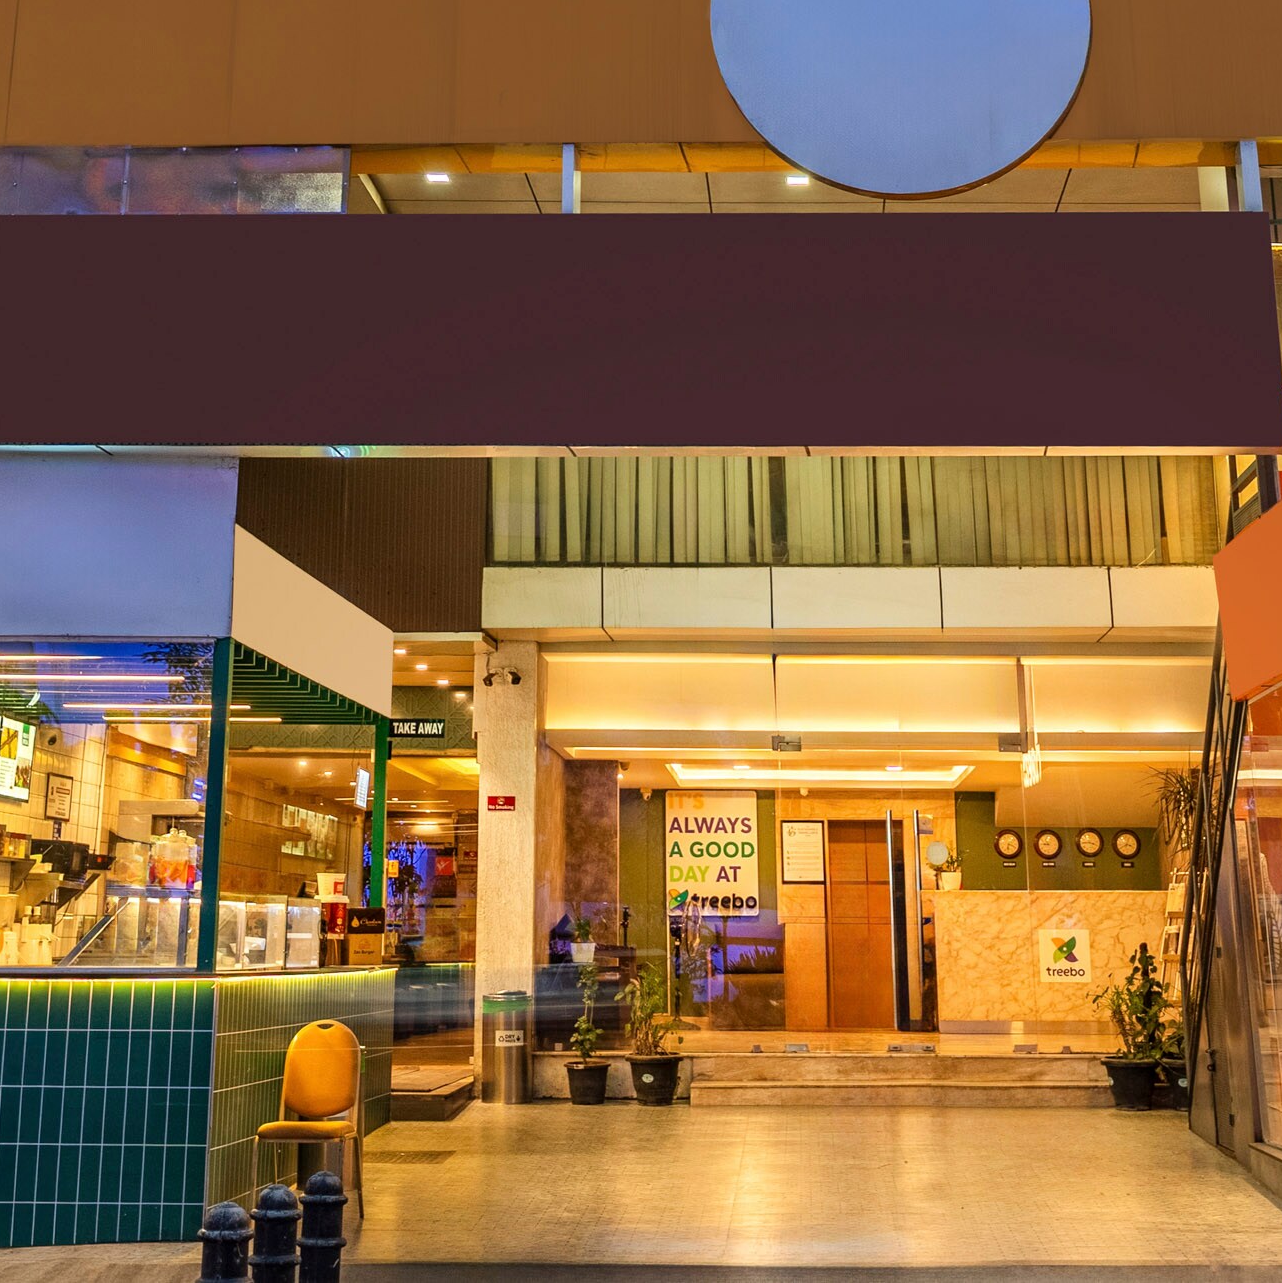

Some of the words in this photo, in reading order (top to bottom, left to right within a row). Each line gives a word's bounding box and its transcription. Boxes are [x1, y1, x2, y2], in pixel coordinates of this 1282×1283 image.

[392, 722, 417, 734] TAKE
[418, 722, 444, 735] AWAY
[668, 792, 704, 810] IT'S
[669, 817, 752, 834] ALWAYS
[669, 841, 683, 858] A
[689, 841, 755, 858] GOOD
[669, 865, 710, 883] DAY
[716, 865, 741, 883] AT
[691, 893, 757, 909] treebo
[1046, 966, 1086, 977] treebo
